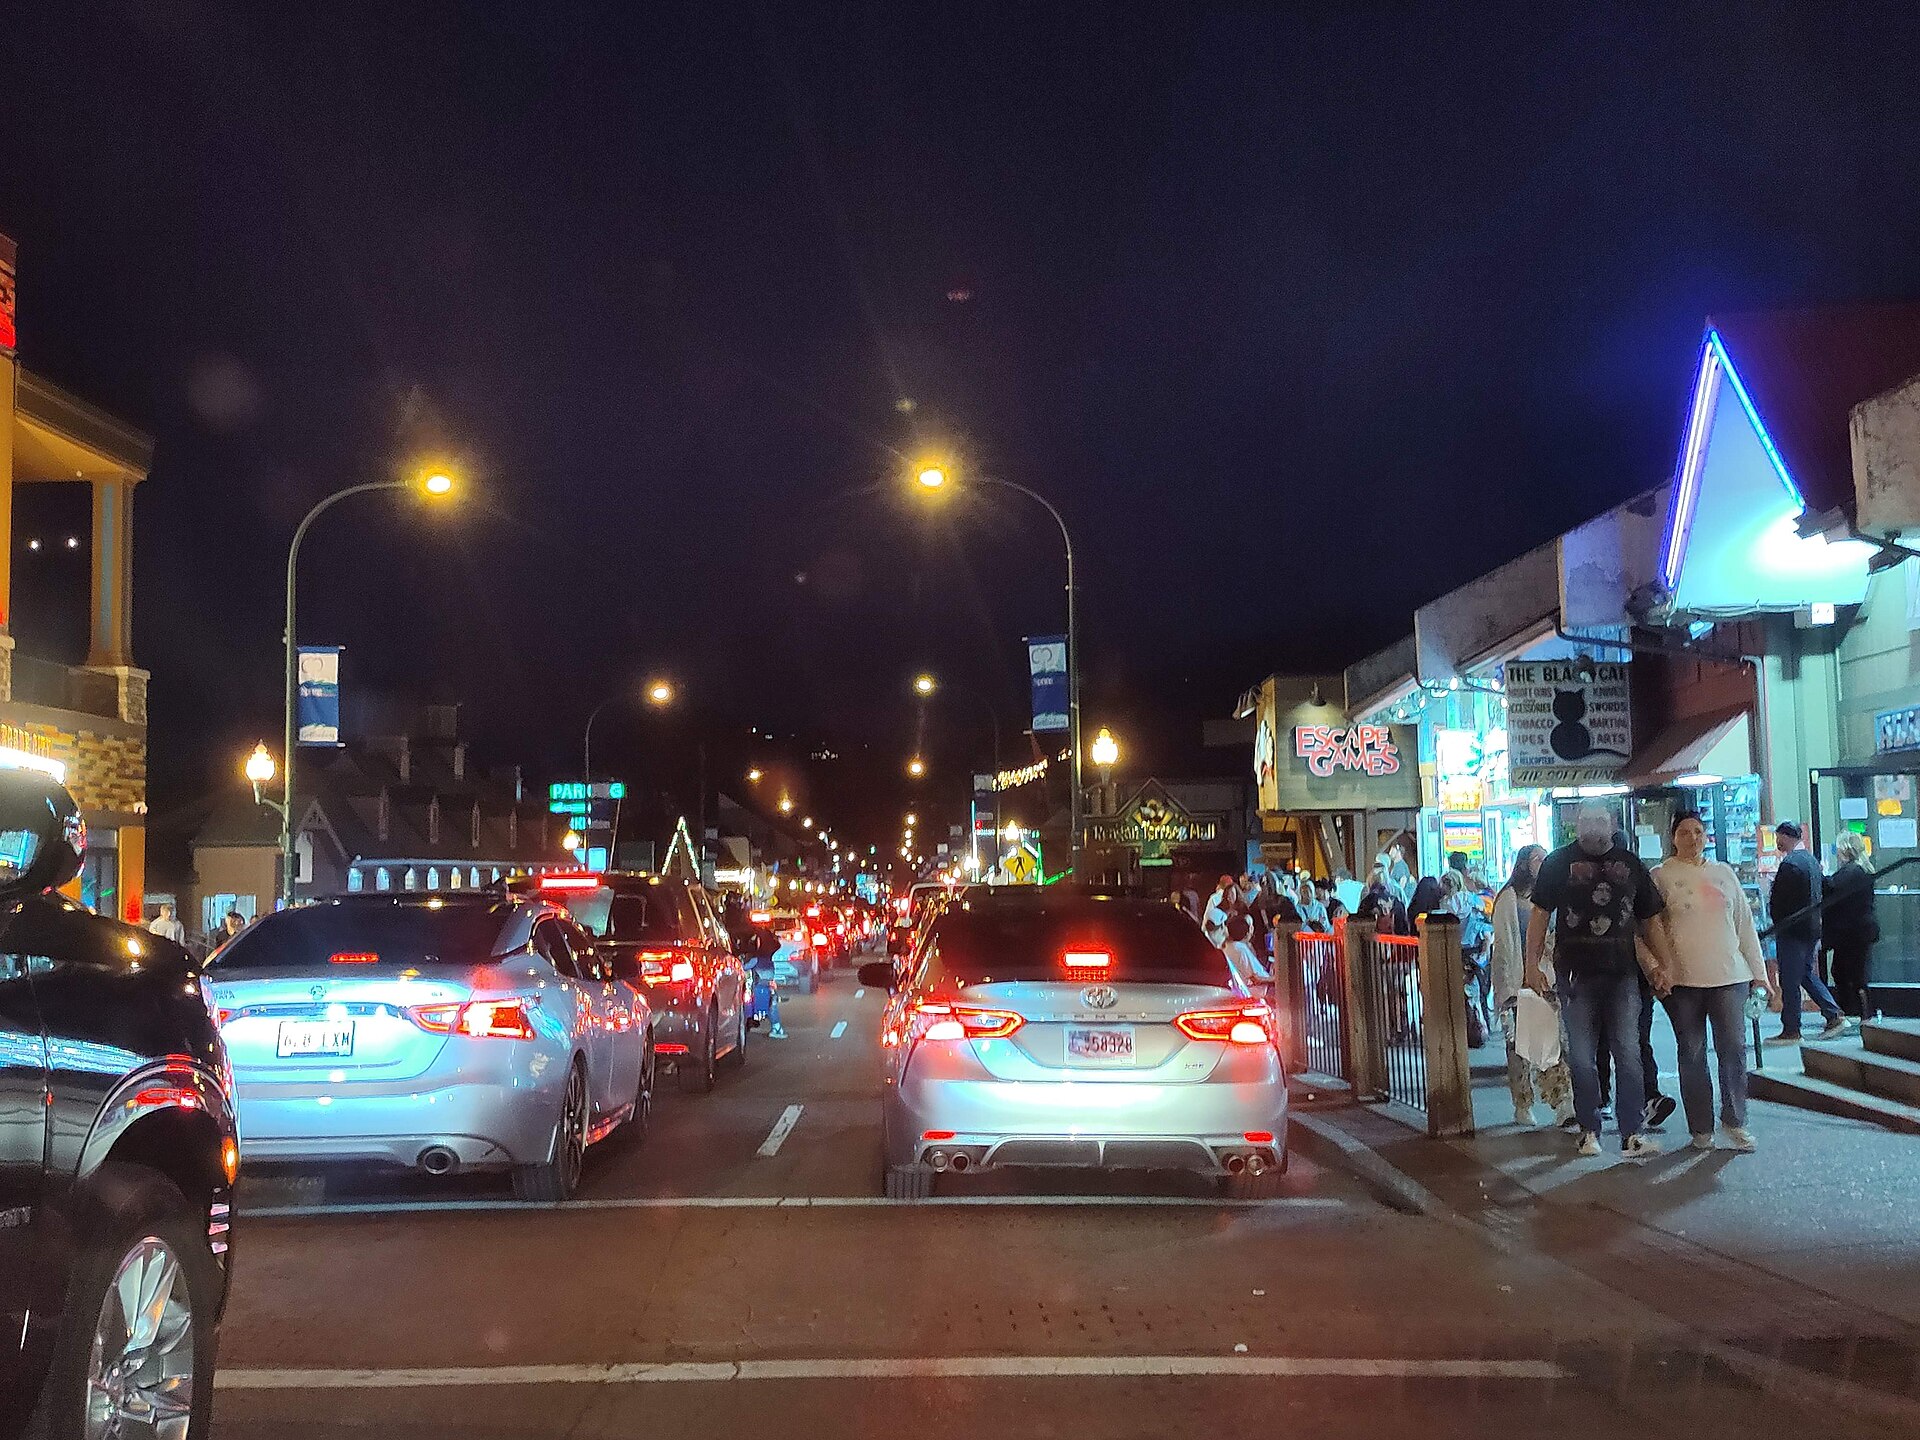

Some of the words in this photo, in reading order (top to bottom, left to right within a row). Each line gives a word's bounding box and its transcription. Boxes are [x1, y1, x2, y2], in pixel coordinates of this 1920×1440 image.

[1508, 667, 1535, 682] THE
[1598, 666, 1625, 681] CAT
[1296, 725, 1390, 757] ESCAPE
[1309, 743, 1399, 777] GAMES
[552, 783, 622, 799] PARG
